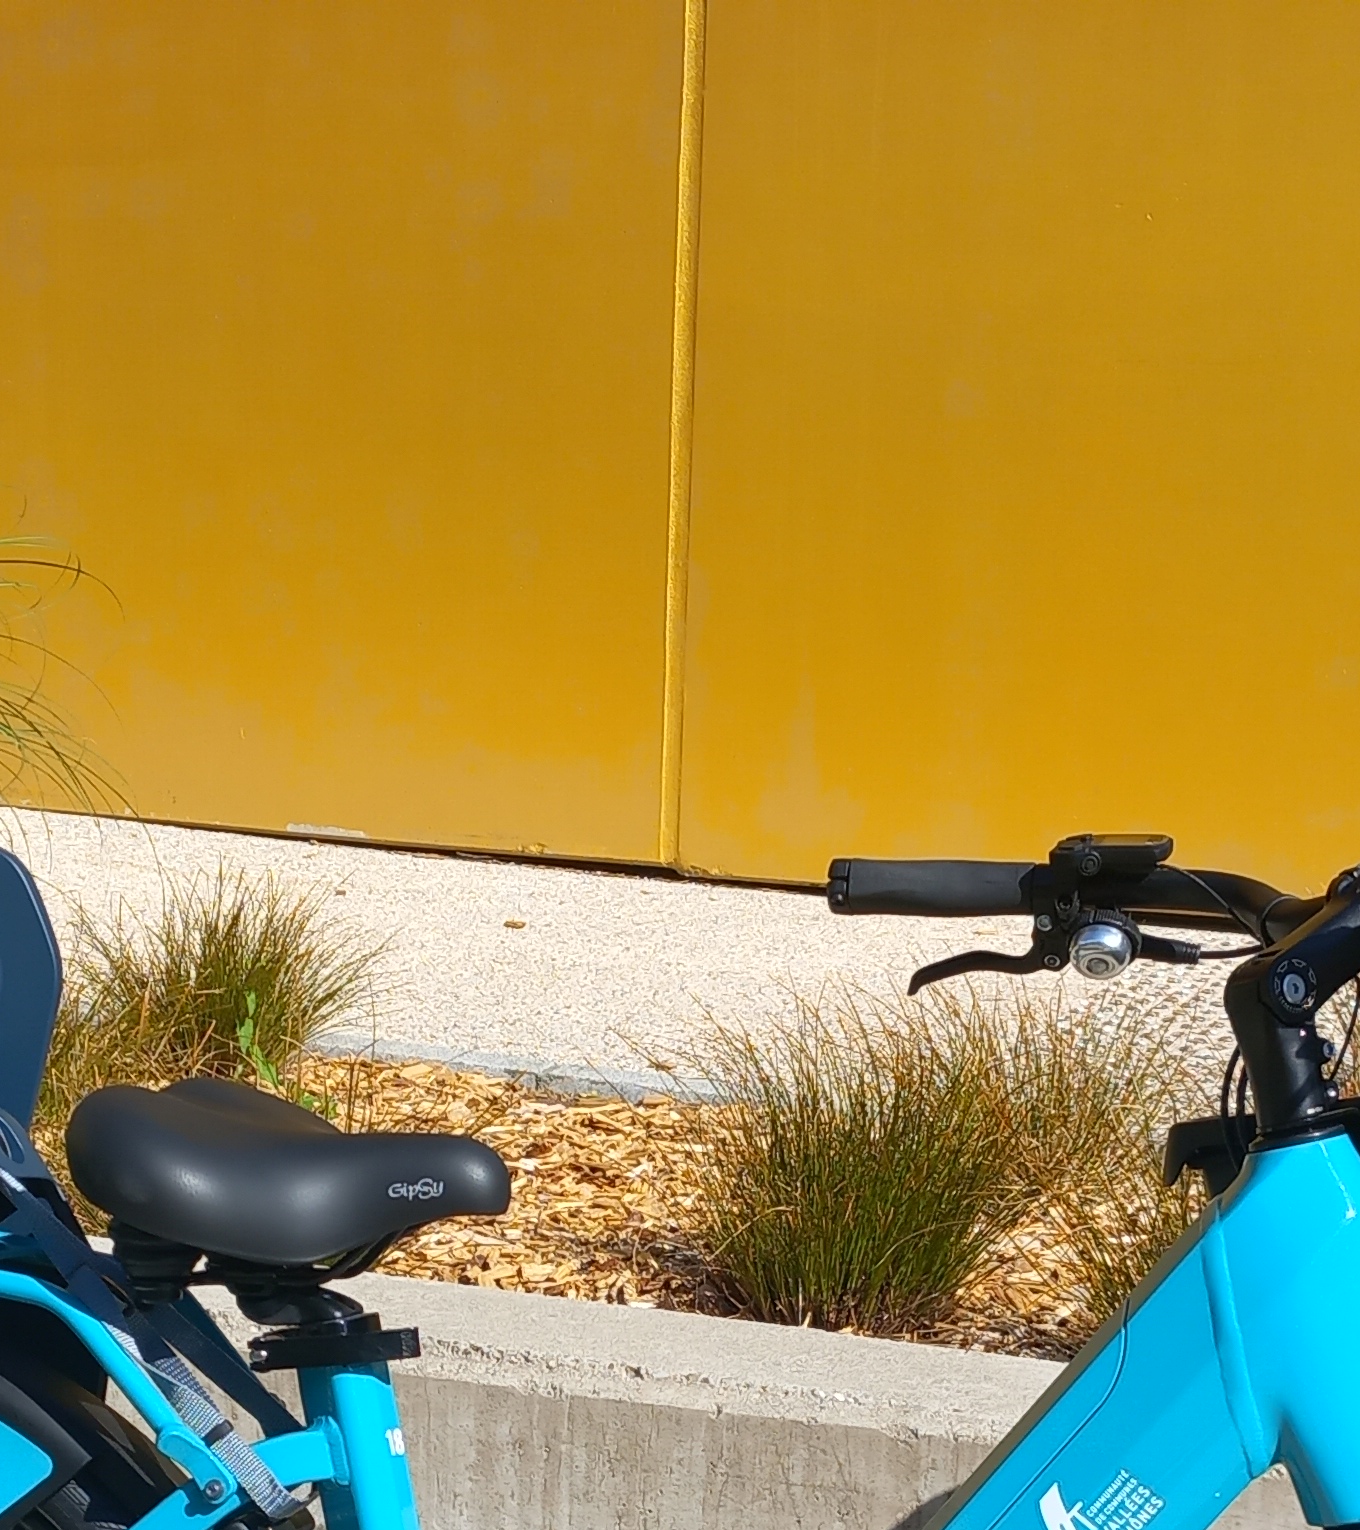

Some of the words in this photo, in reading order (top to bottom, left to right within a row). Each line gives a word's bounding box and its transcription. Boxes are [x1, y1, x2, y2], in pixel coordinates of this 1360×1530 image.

[385, 1428, 405, 1456] 18
[1095, 1512, 1107, 1525] DE
[1103, 1478, 1138, 1516] COMMUNES
